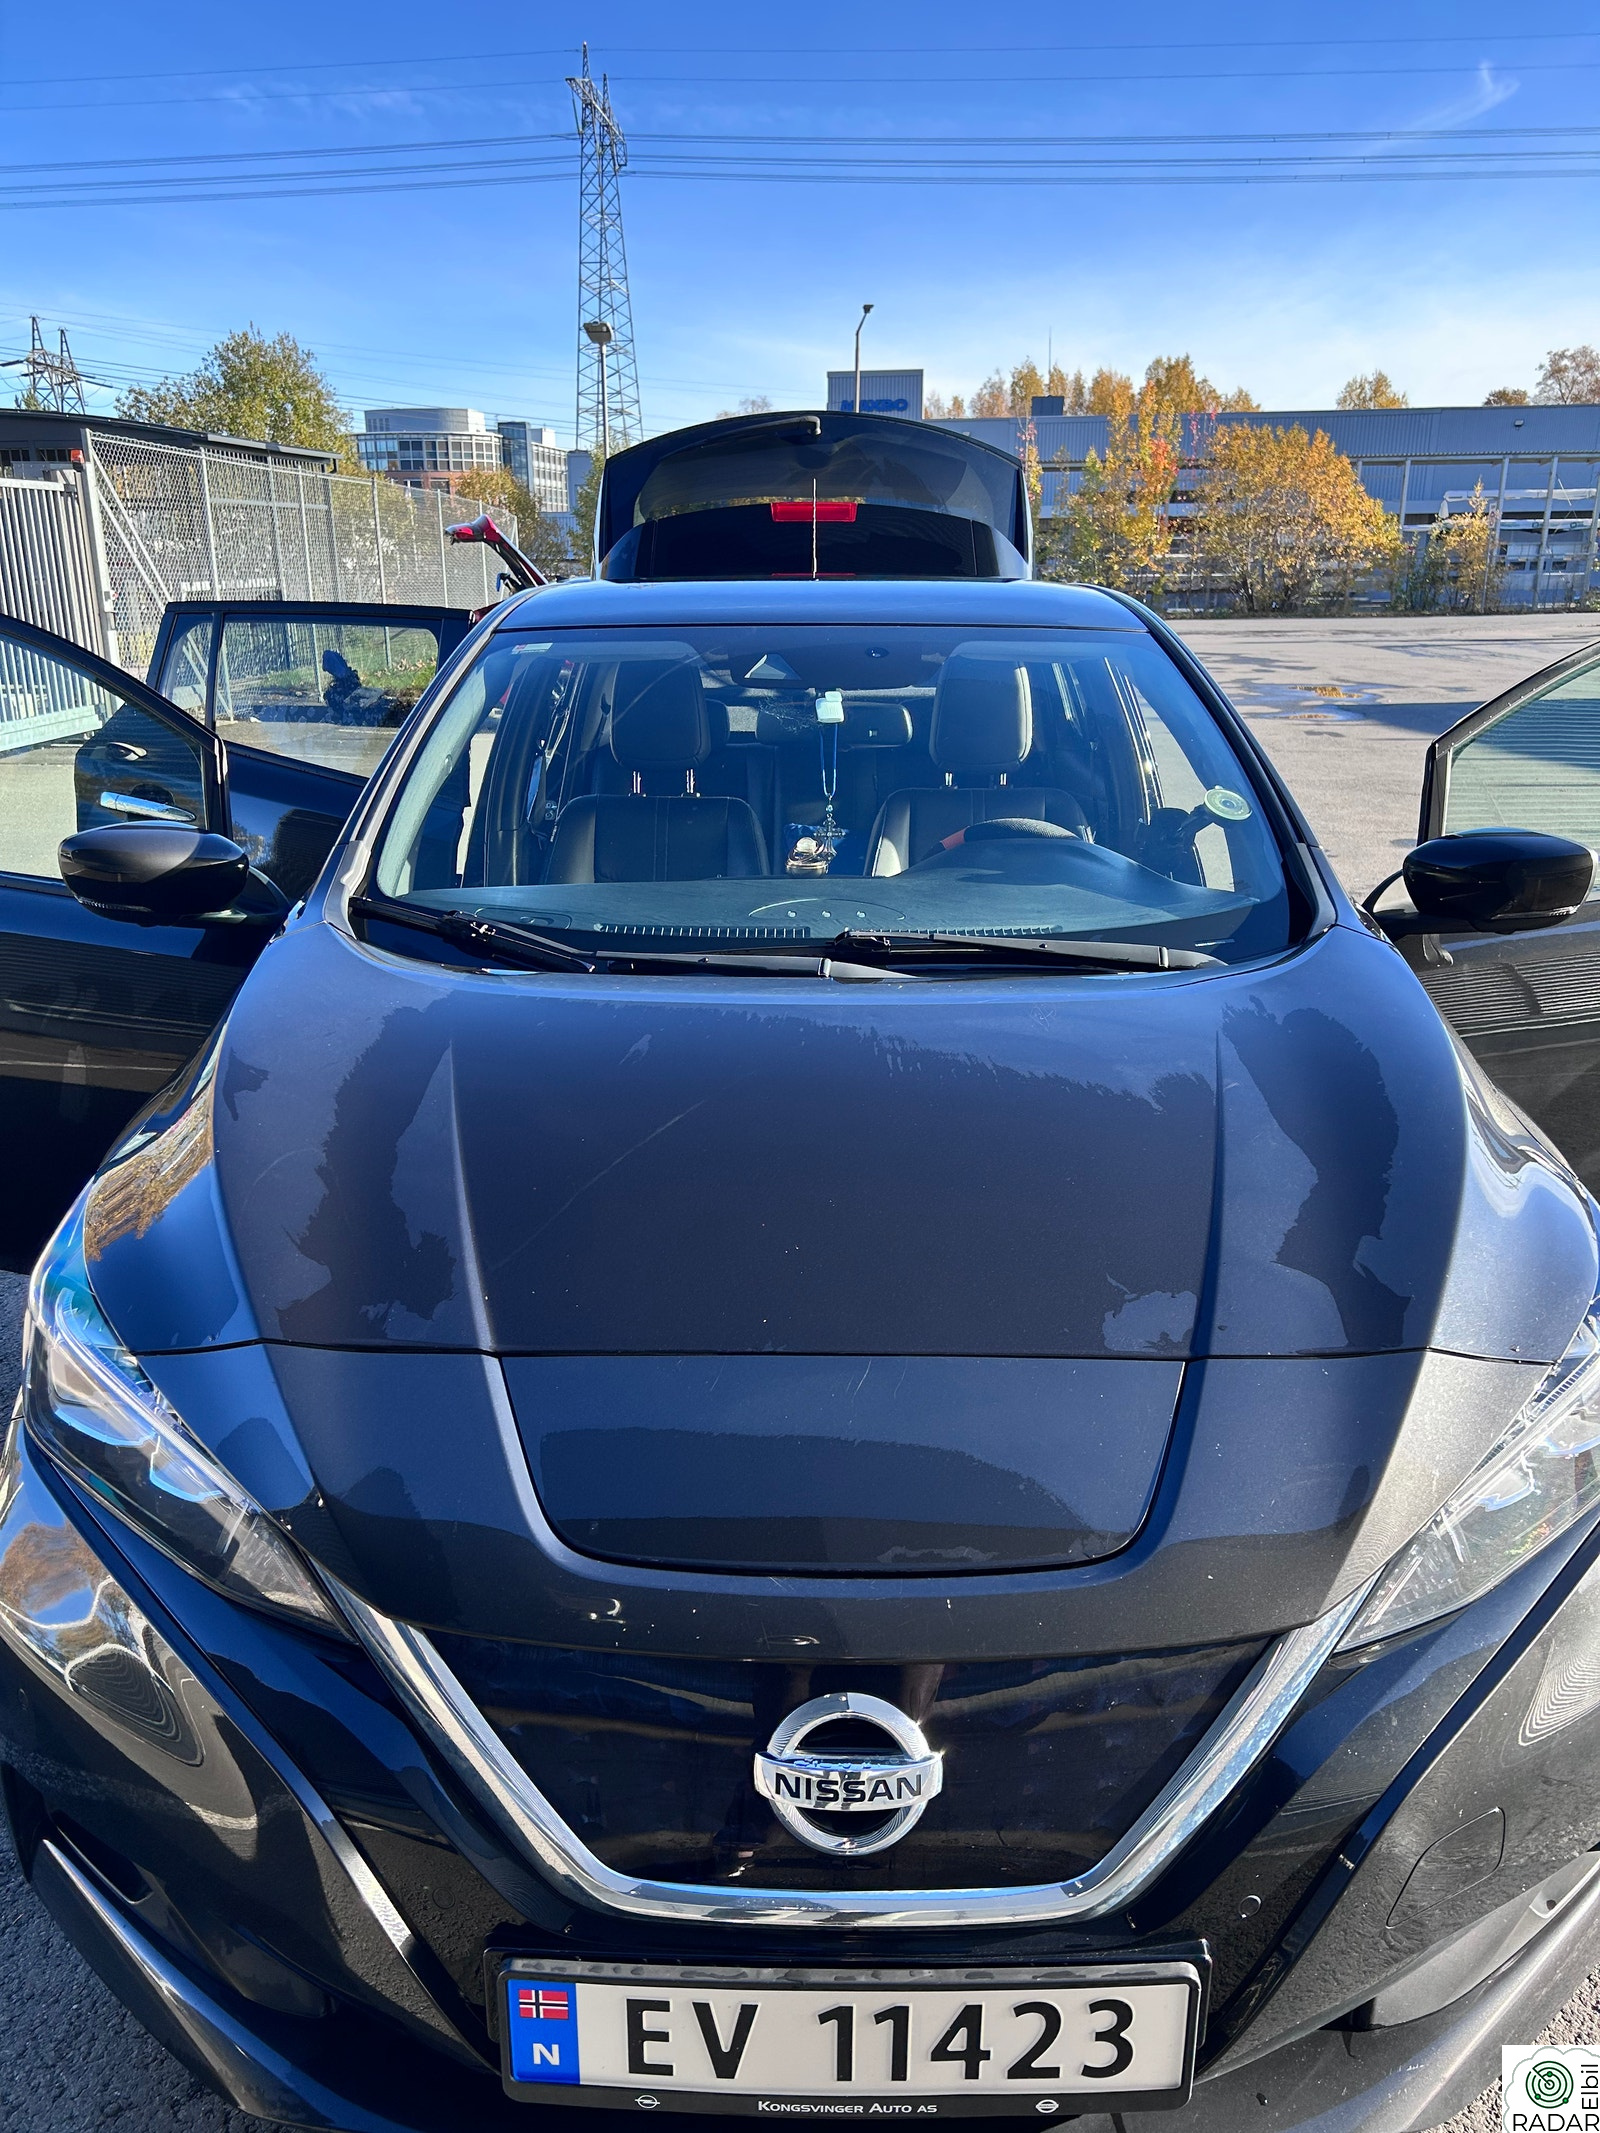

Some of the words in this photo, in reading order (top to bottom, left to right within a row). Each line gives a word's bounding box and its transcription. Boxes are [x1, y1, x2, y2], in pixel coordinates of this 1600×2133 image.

[774, 1772, 922, 1803] NISSAN
[626, 1998, 759, 2079] EV
[817, 1998, 1134, 2082] 11423
[532, 2043, 560, 2066] N
[757, 2100, 864, 2114] KONGSVINGER
[868, 2102, 913, 2114] AUTO
[916, 2104, 938, 2113] AS
